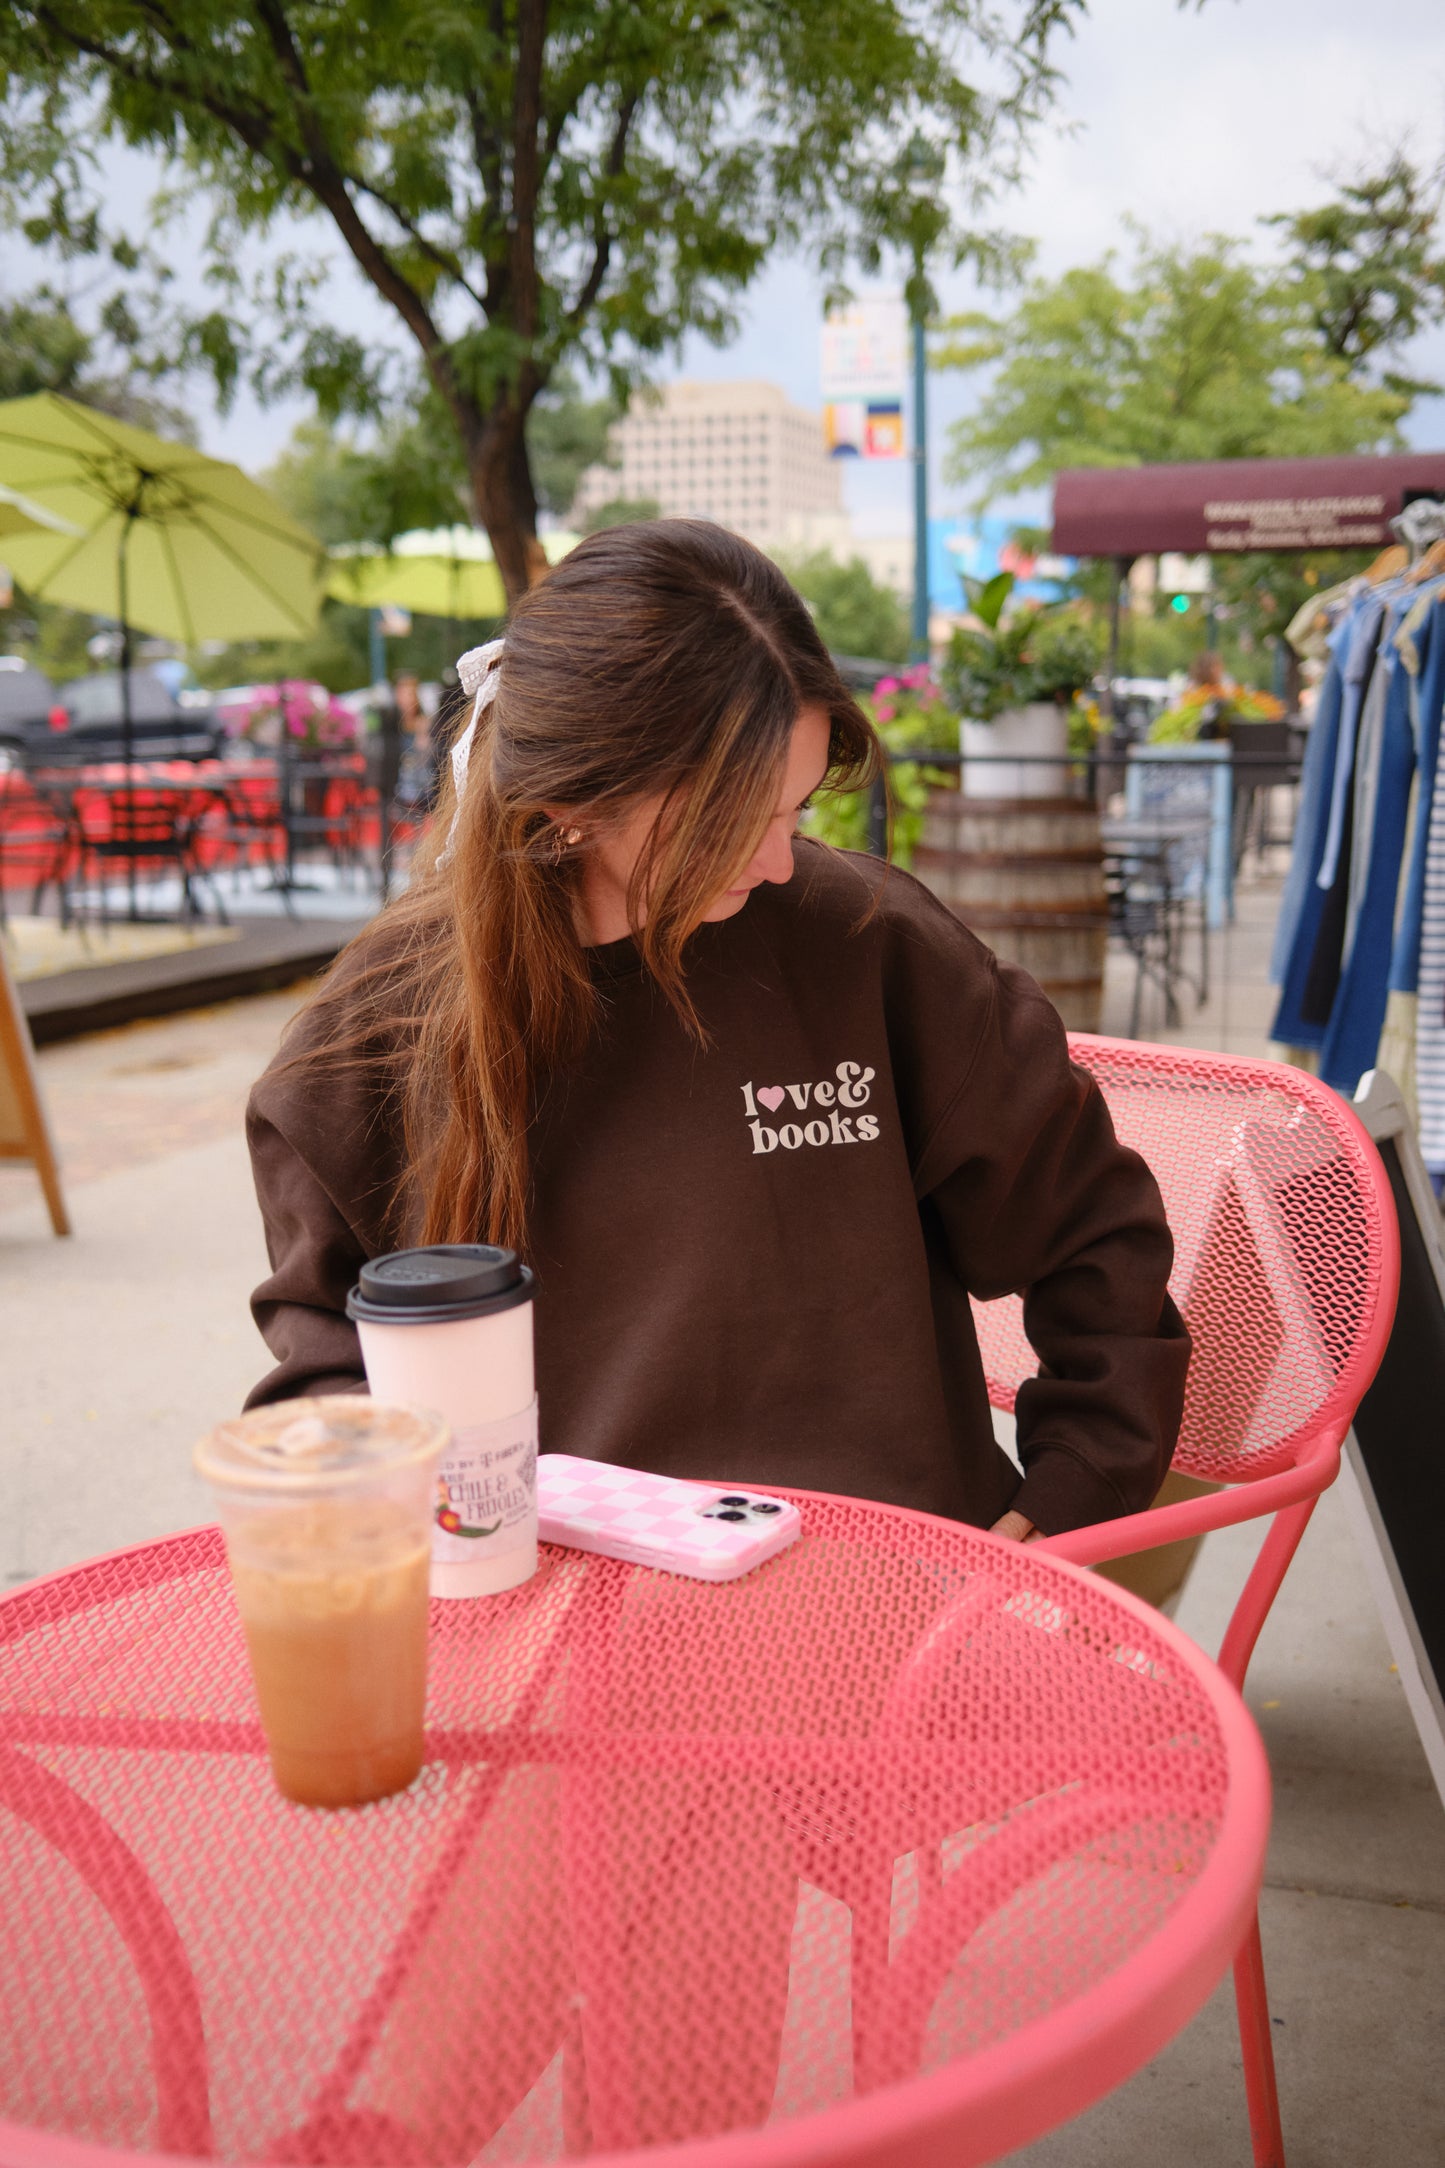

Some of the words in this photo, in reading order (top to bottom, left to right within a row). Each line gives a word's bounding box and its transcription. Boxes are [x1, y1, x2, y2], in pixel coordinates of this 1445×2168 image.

[748, 1109, 881, 1155] books
[448, 1477, 494, 1503] CHILE
[467, 1486, 526, 1520] FRIJOLES
